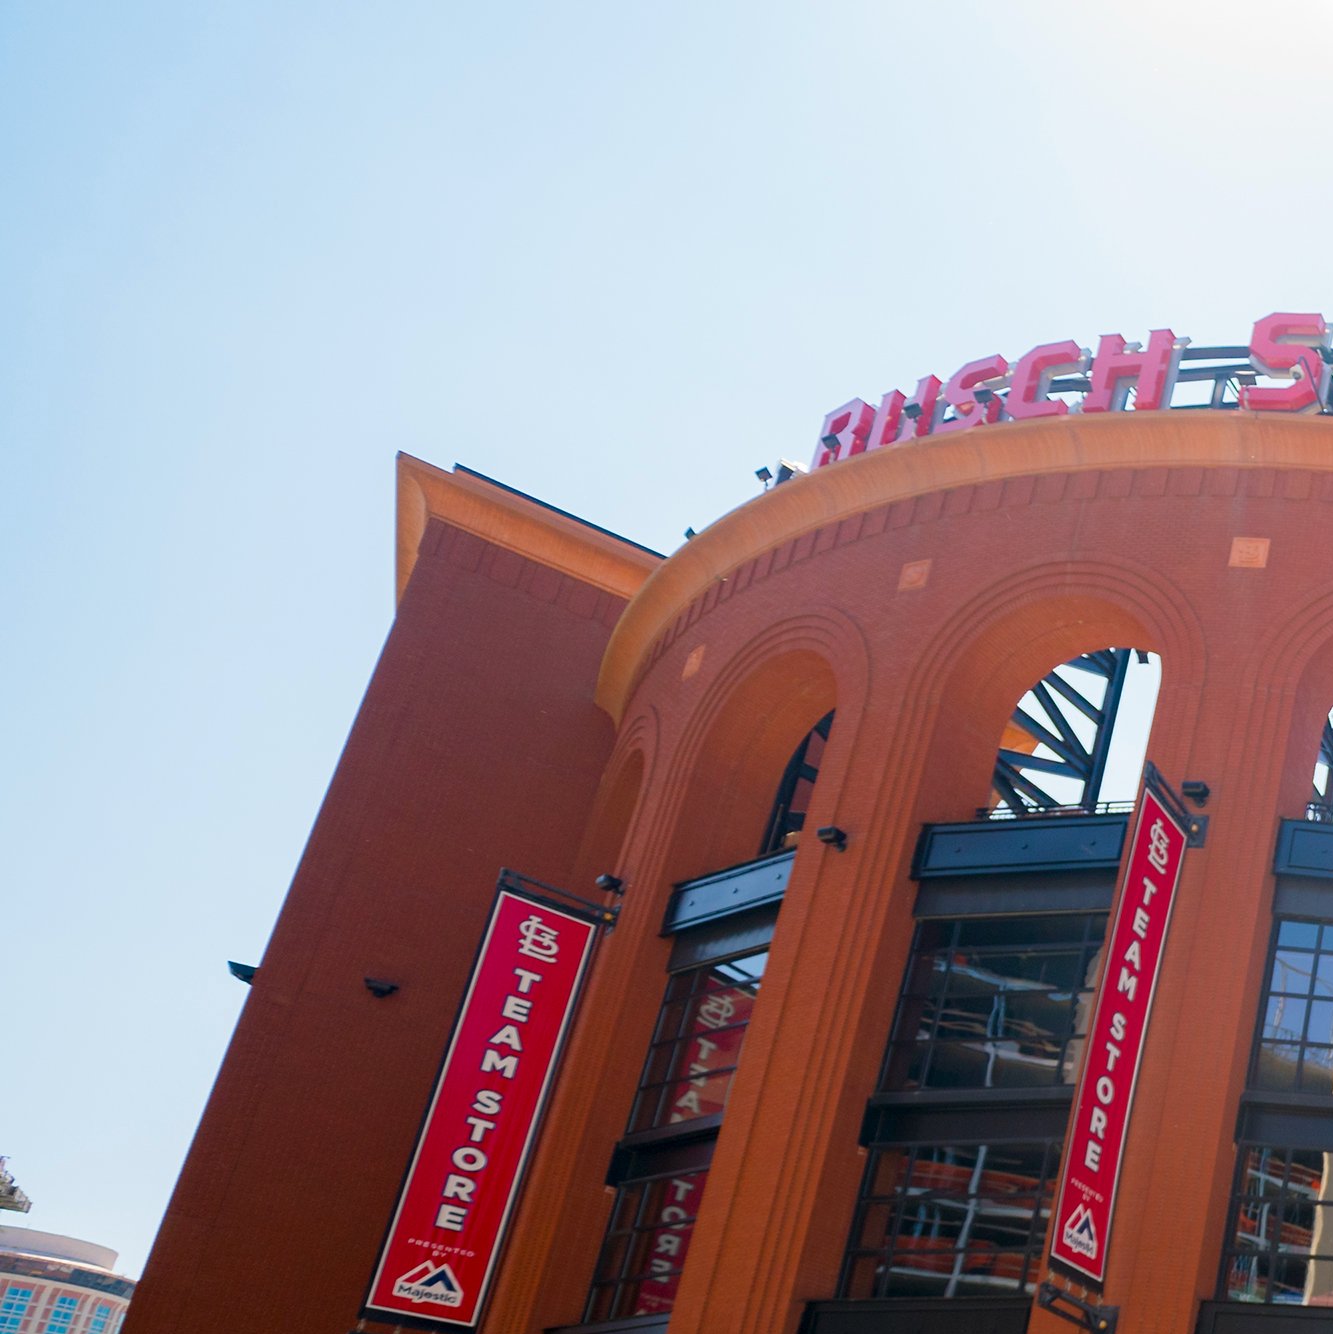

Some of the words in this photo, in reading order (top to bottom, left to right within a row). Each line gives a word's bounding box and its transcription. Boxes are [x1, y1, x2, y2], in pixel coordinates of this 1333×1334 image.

[812, 328, 1190, 468] BUSCH
[1116, 876, 1158, 1003] TEAM
[479, 966, 543, 1080] TEAM
[1082, 1011, 1127, 1174] STORE
[433, 1088, 504, 1234] STORE
[397, 1284, 457, 1304] Majestic
[408, 1238, 475, 1257] PRESENTED
